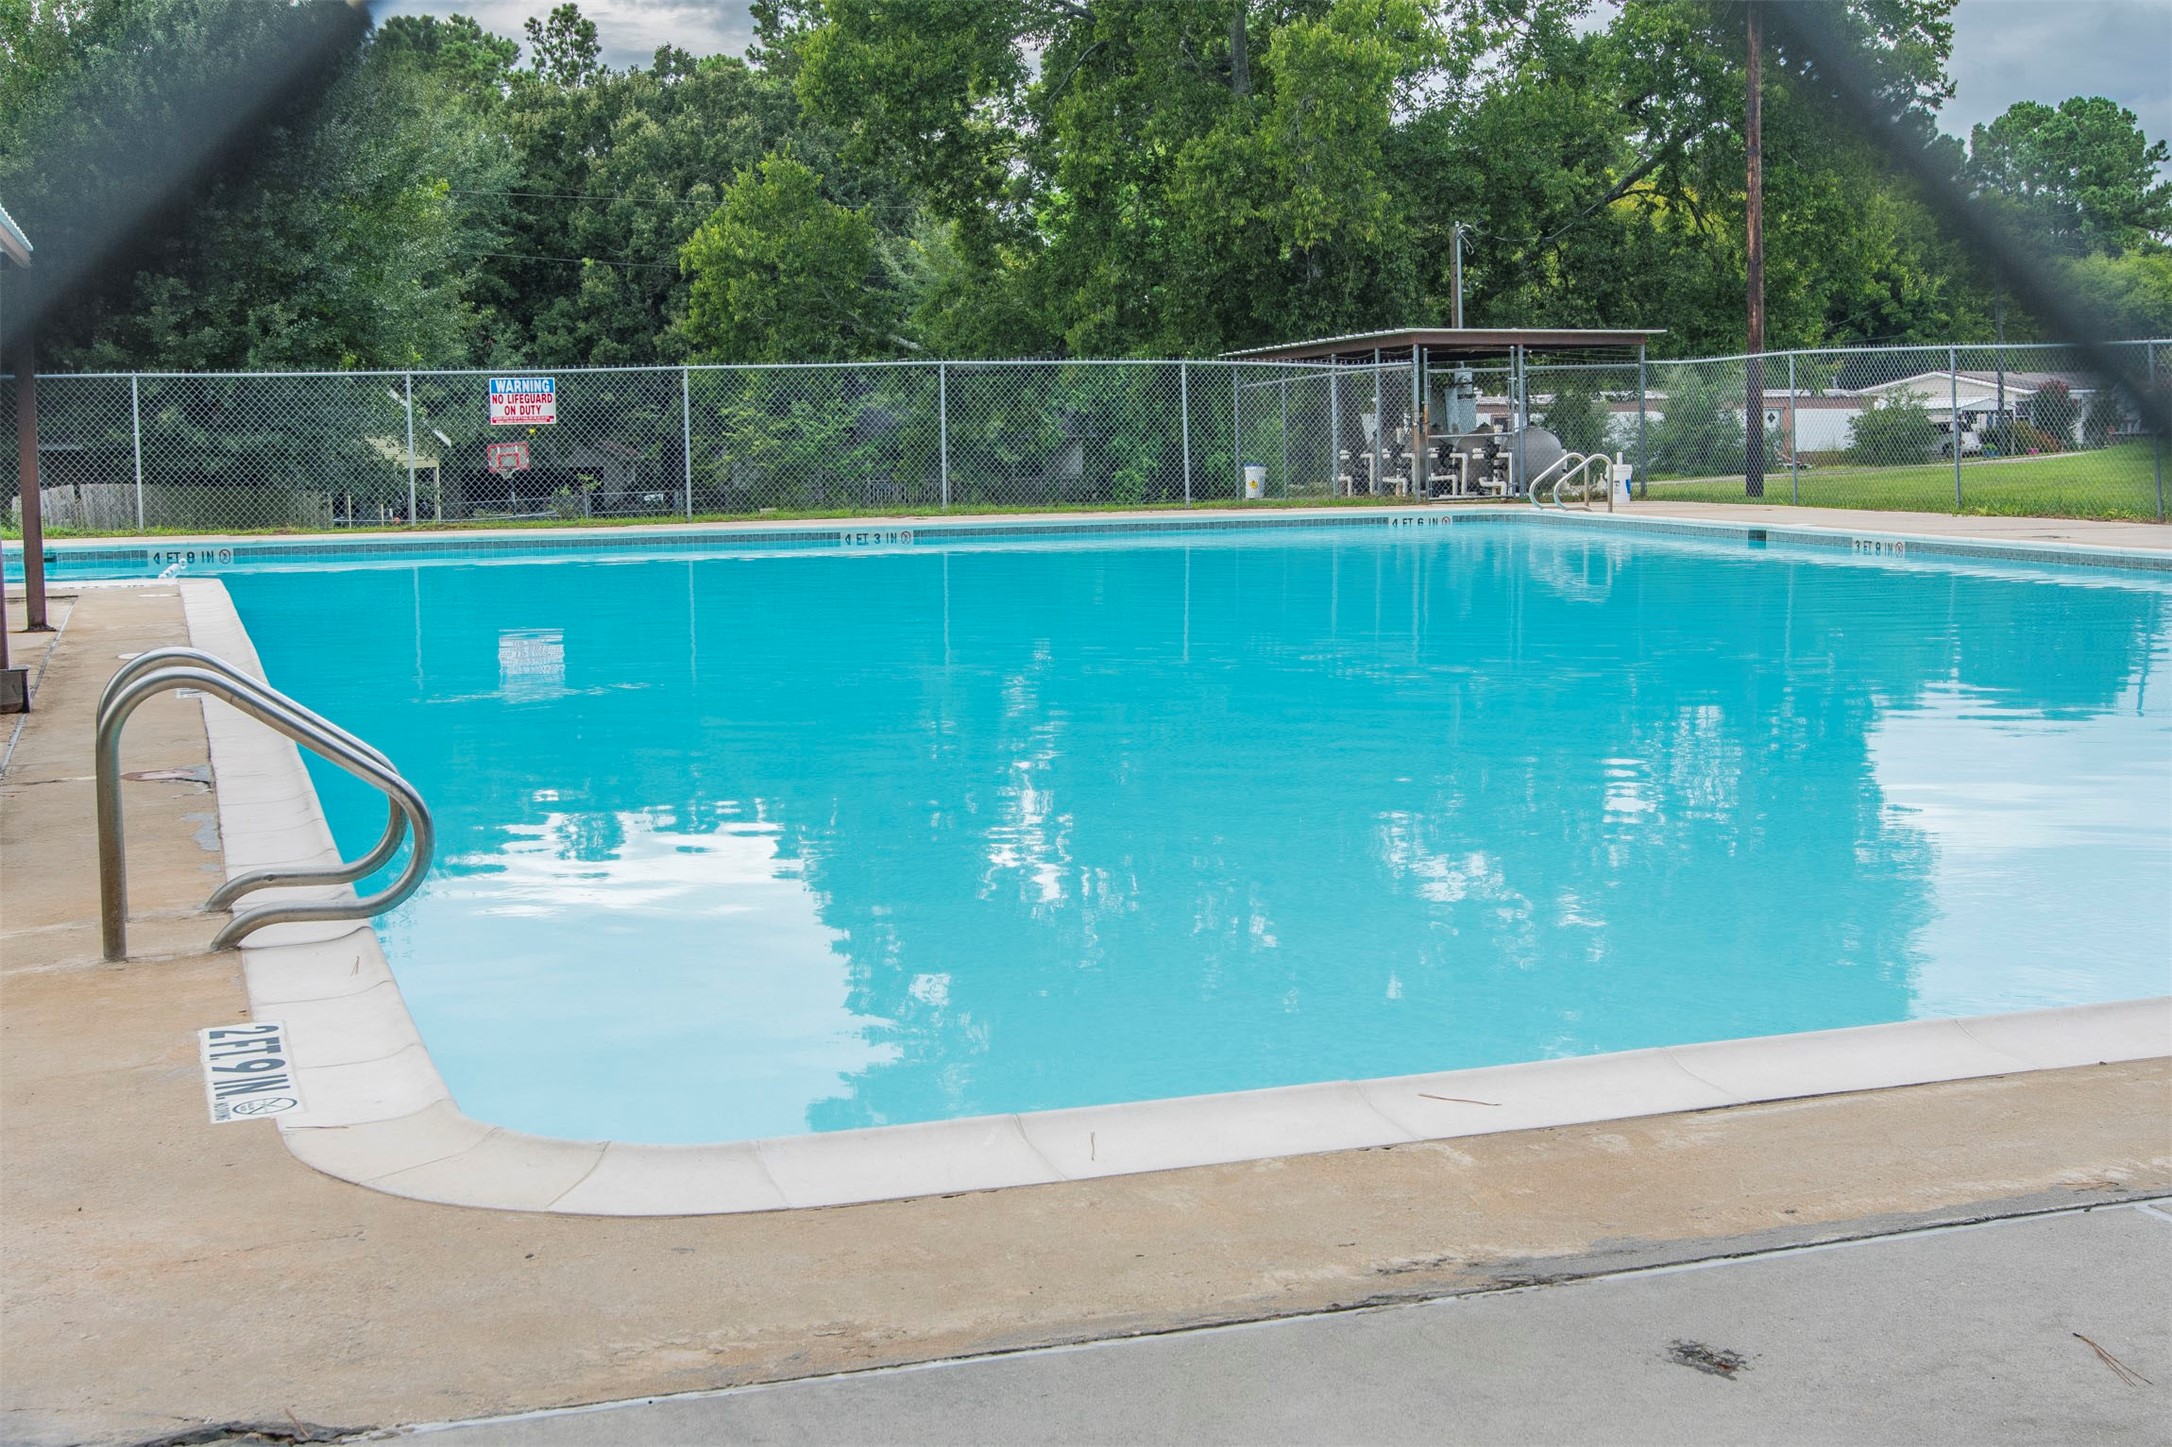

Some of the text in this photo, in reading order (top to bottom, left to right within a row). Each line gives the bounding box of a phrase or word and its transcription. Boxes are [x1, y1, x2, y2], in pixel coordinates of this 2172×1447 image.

[495, 380, 550, 393] WARNING
[492, 394, 553, 404] NO LIFEGUARD
[504, 405, 541, 415] ON DUTY
[1392, 517, 1438, 528] 4 FT 6 IN
[886, 532, 897, 544] IN
[1884, 542, 1893, 556] IN
[201, 550, 214, 563] IN
